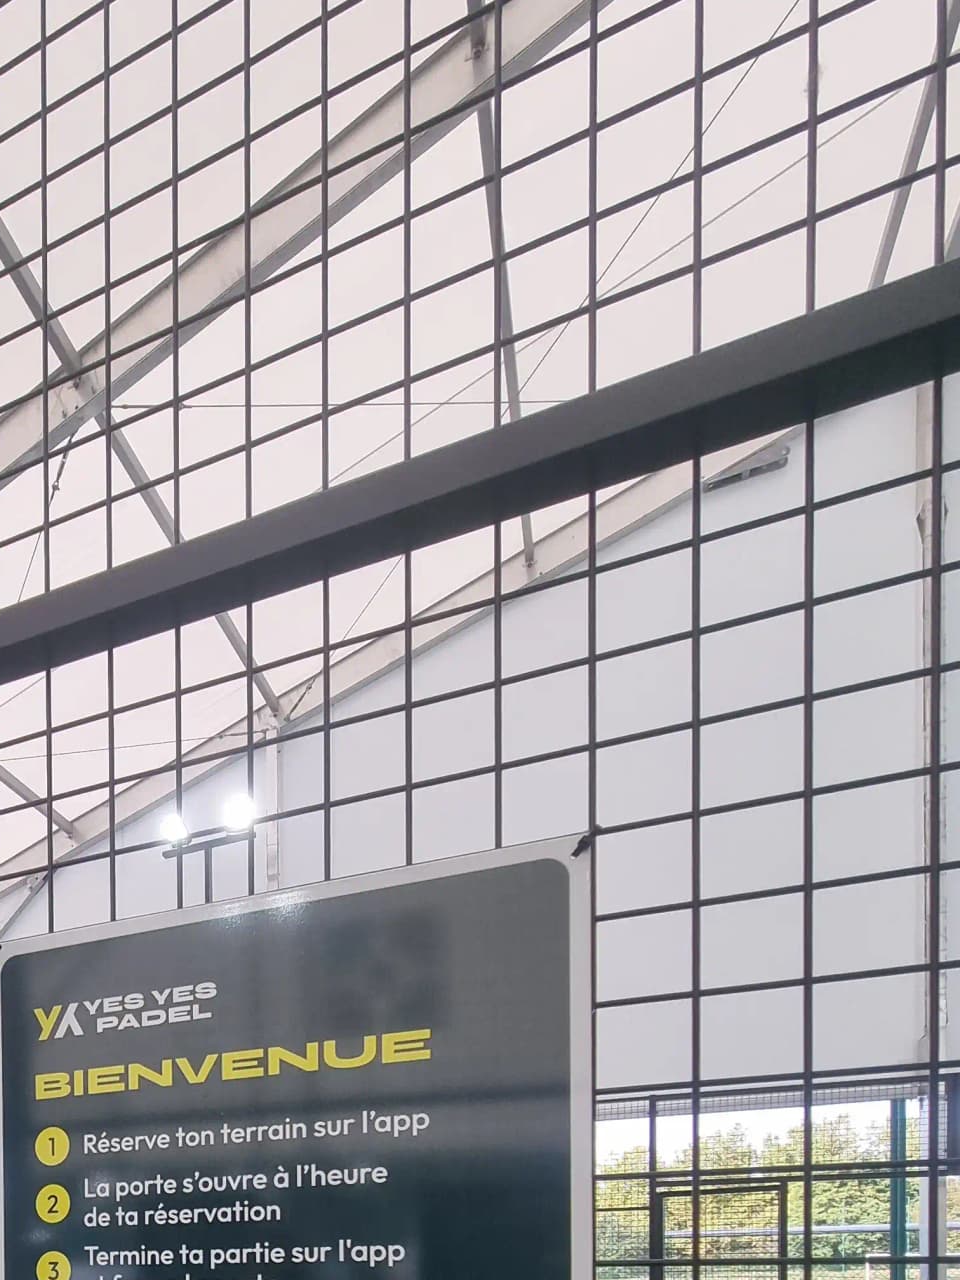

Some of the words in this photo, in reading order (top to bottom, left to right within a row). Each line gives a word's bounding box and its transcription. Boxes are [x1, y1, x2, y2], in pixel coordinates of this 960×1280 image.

[83, 993, 144, 1015] YES
[151, 982, 217, 1005] YES
[96, 1004, 212, 1033] PADEL
[34, 1029, 432, 1101] BIENVENUE
[48, 1138, 56, 1156] 1
[84, 1133, 170, 1155] Réserve
[175, 1127, 215, 1148] ton
[220, 1118, 307, 1144] terrain
[314, 1117, 355, 1138] sur
[362, 1110, 430, 1137] l'app
[84, 1178, 110, 1199] La
[115, 1175, 177, 1201] porte
[182, 1171, 267, 1194] s'ouvre
[273, 1167, 289, 1189] à
[296, 1164, 388, 1188] l'heure
[47, 1195, 58, 1213] 2
[84, 1208, 110, 1228] de
[115, 1207, 138, 1226] ta
[144, 1201, 281, 1225] réservation
[84, 1245, 174, 1266] Termine
[179, 1244, 204, 1264] ta
[210, 1241, 285, 1270] partie
[291, 1246, 332, 1265] sur
[338, 1239, 405, 1267] l'app
[48, 1262, 59, 1280] 3
